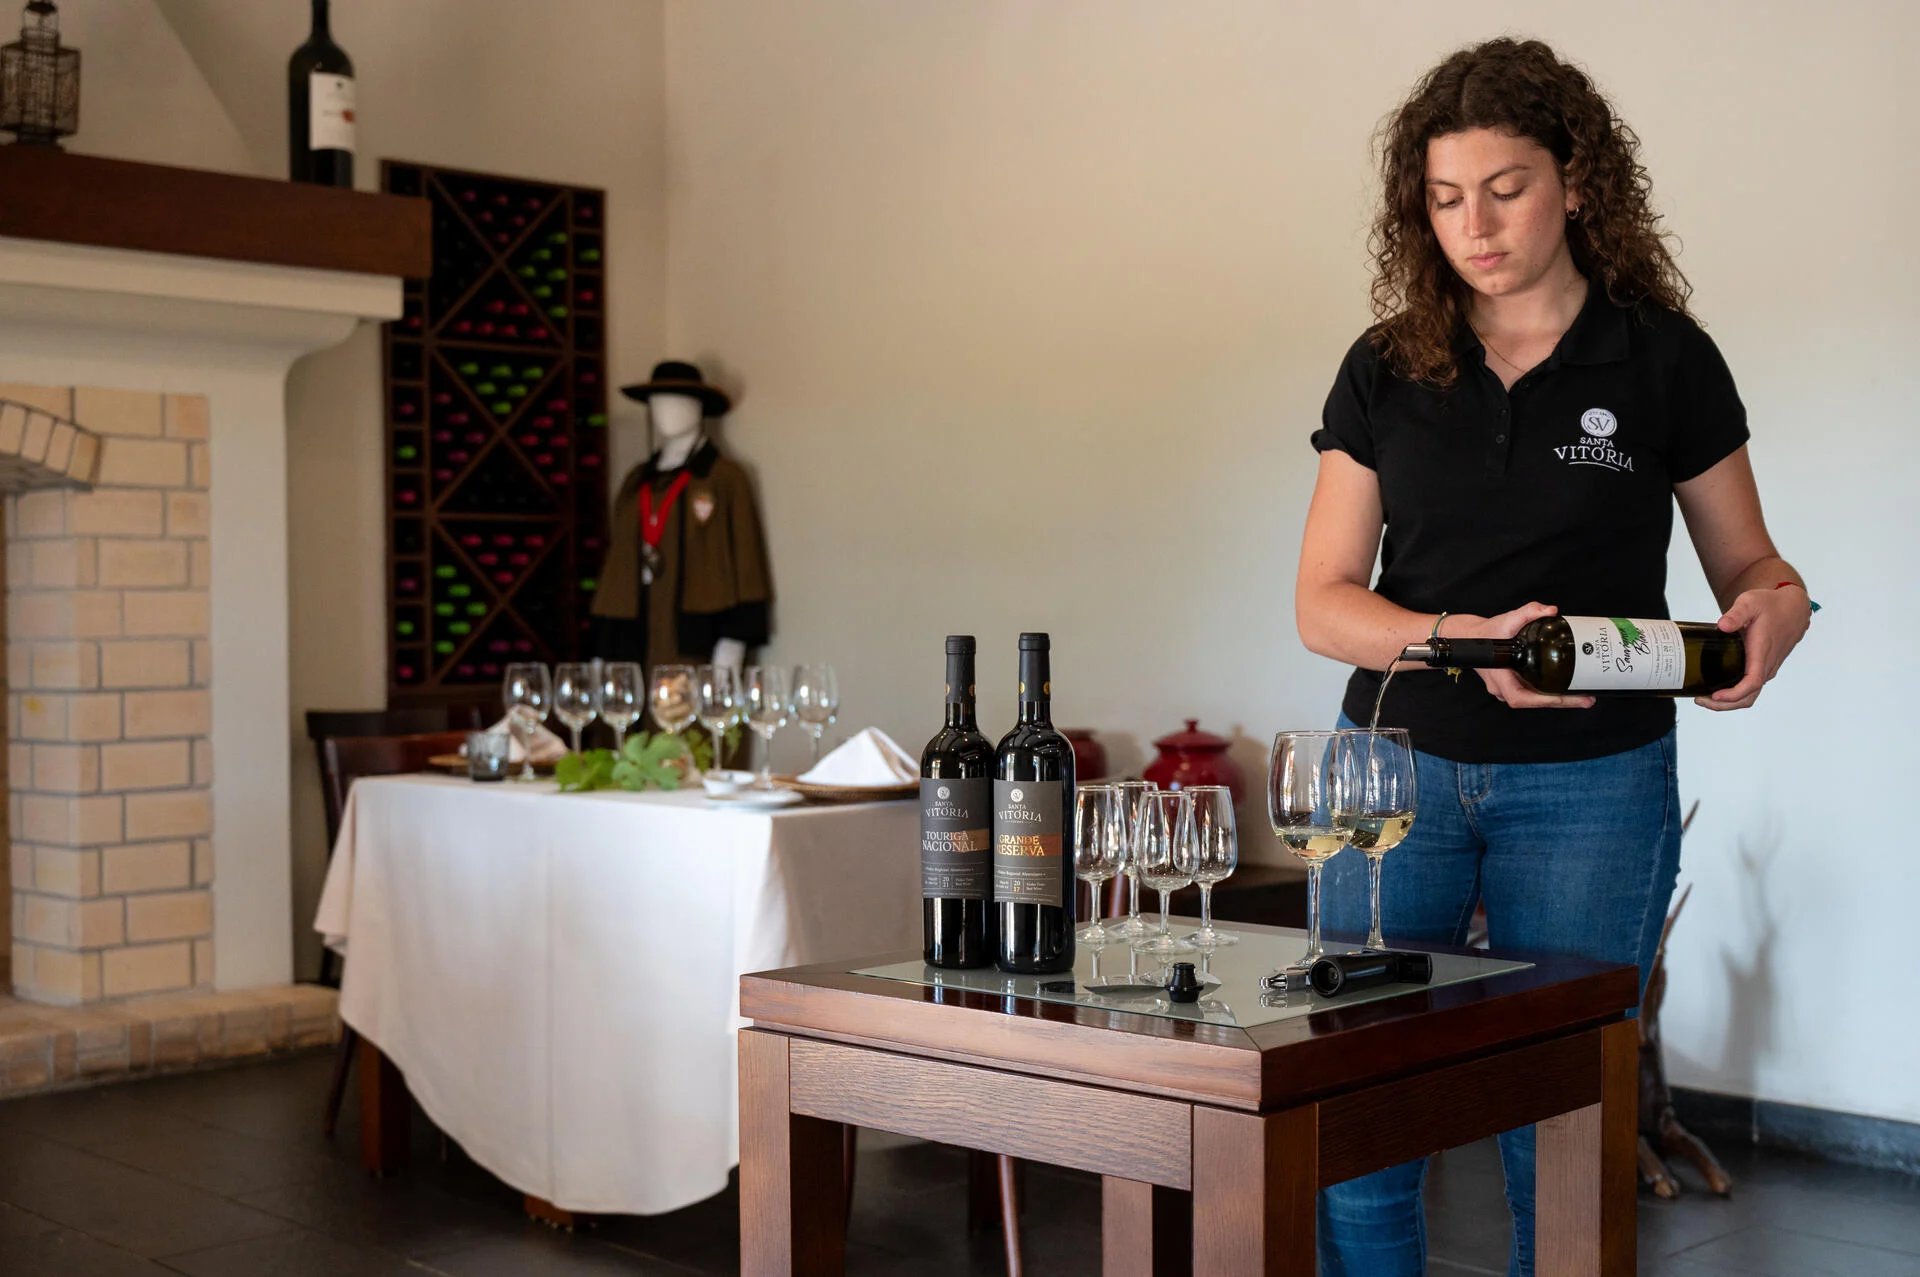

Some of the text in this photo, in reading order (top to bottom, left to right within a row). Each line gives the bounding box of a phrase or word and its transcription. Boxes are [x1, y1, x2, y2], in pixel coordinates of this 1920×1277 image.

[1580, 436, 1615, 448] SANTA
[925, 830, 969, 841] TOURIGA
[999, 834, 1040, 845] GRANDE
[922, 840, 978, 852] NACIONAL
